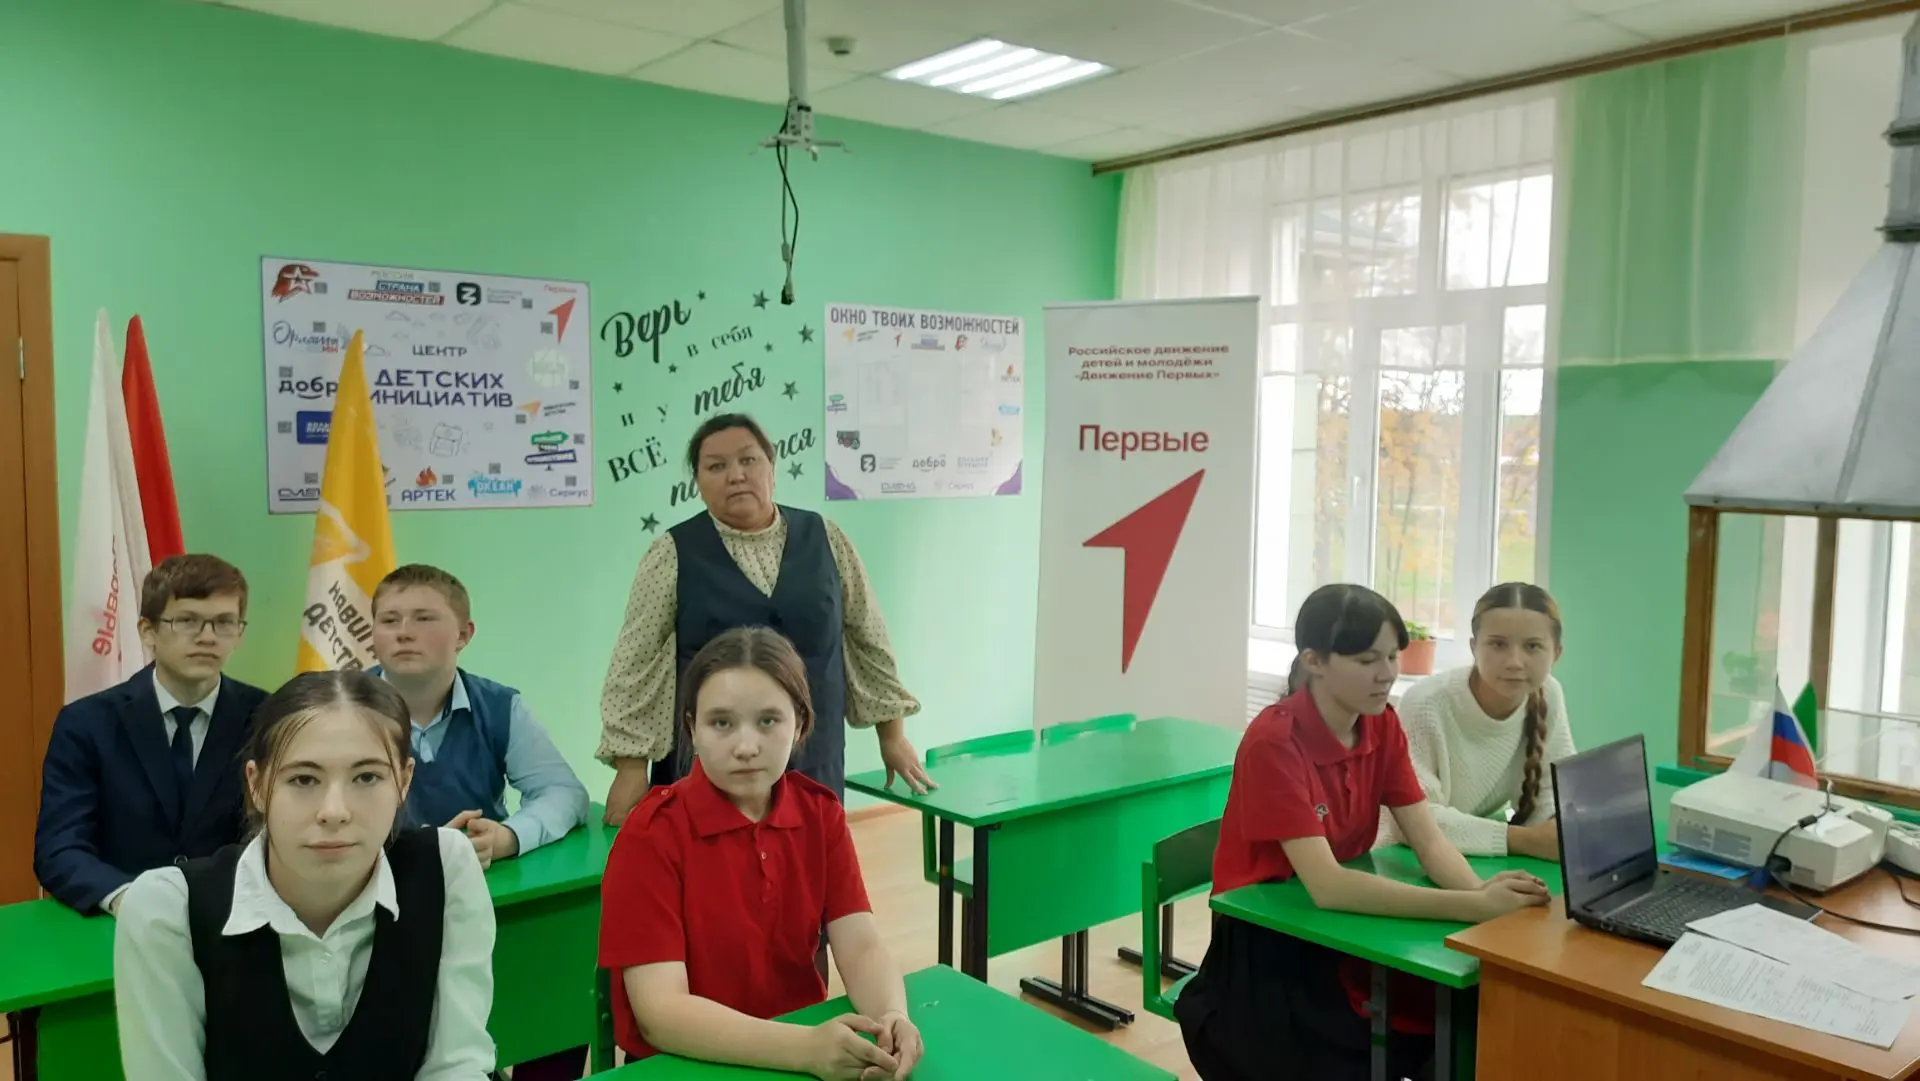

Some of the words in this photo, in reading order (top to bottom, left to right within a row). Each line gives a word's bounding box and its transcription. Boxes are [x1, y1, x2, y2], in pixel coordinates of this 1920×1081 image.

[601, 299, 691, 363] Верь
[830, 307, 867, 325] ОКНО
[872, 310, 915, 328] ТВОИХ
[920, 314, 1020, 335] ВОЗМОЖНОСТЕЙ
[412, 344, 468, 357] ЦЕНТР
[686, 343, 699, 357] в
[711, 324, 754, 349] себя
[1068, 345, 1150, 356] Российское
[1153, 345, 1229, 355] движение
[1081, 358, 1122, 369] детей
[1137, 357, 1213, 368] молодёжи
[278, 376, 338, 398] добр
[374, 369, 504, 389] ДЕТСКИХ
[620, 413, 634, 427] и
[694, 361, 766, 415] тебя
[1079, 424, 1210, 460] Первые
[607, 436, 667, 483] ВСЁ
[402, 489, 456, 501] АРТЕК
